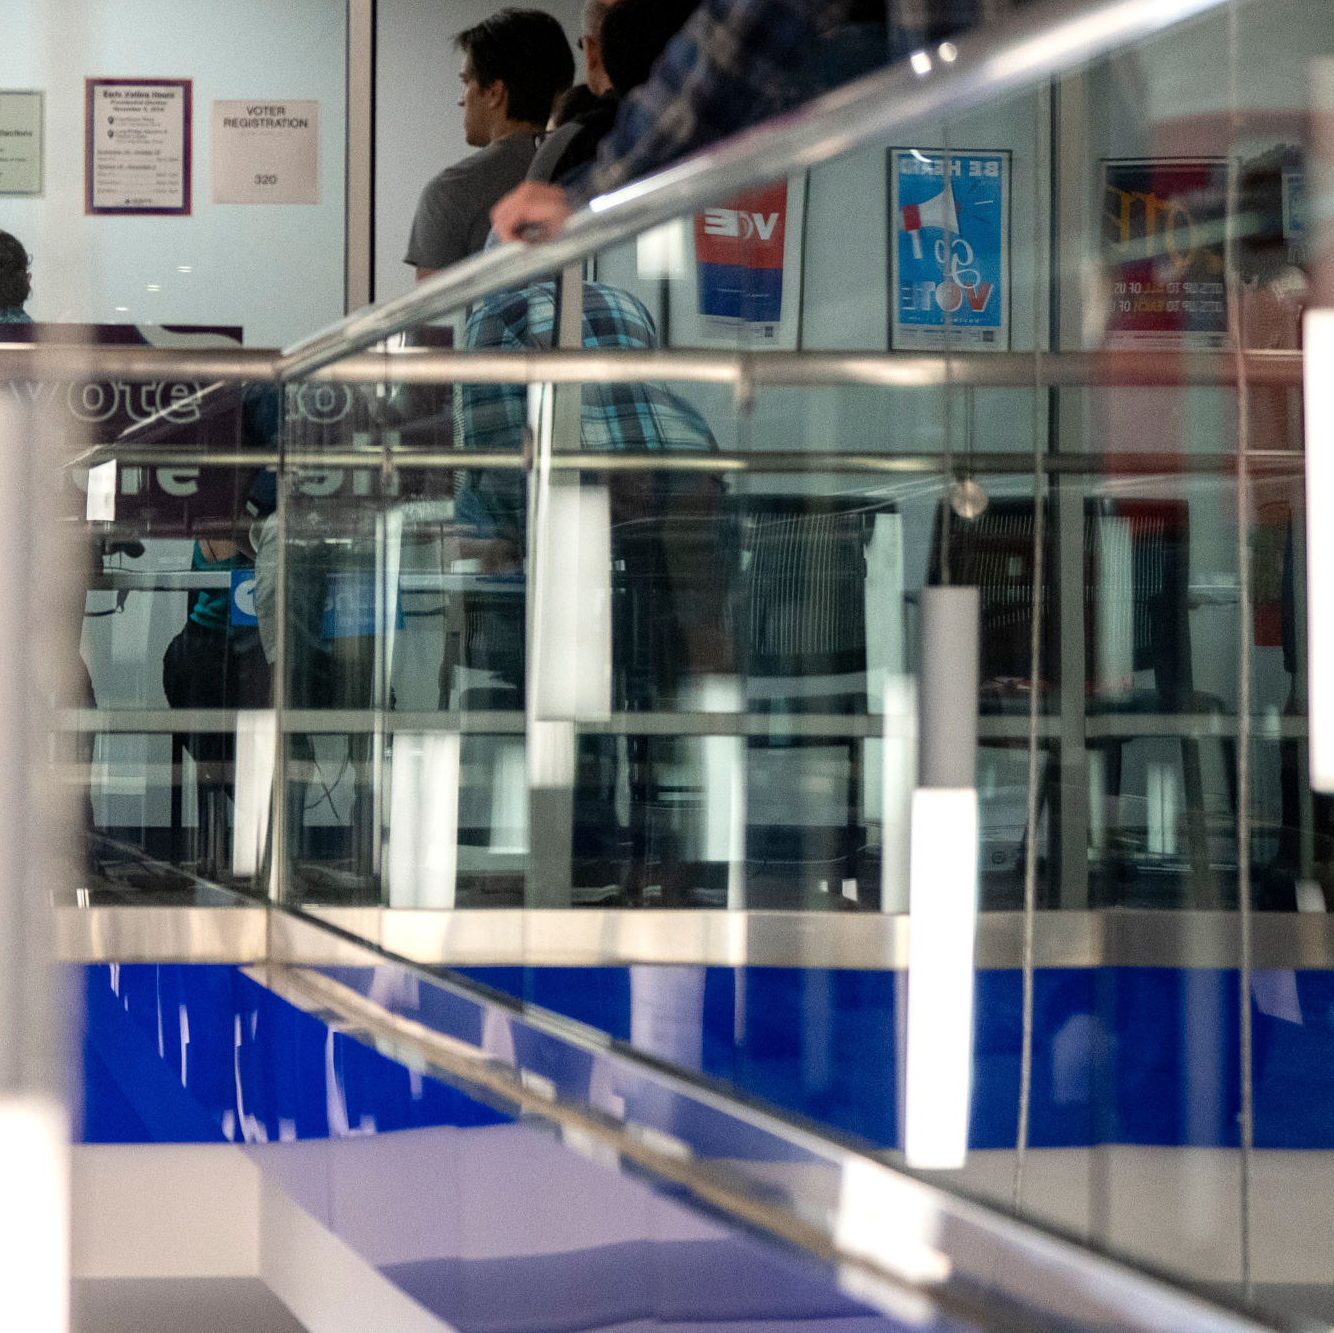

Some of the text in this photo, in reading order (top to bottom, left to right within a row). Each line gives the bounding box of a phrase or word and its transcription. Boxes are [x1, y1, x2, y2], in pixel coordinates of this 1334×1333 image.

[246, 106, 285, 116] VOTER
[223, 118, 308, 128] REGISTRATION
[254, 175, 277, 185] 320
